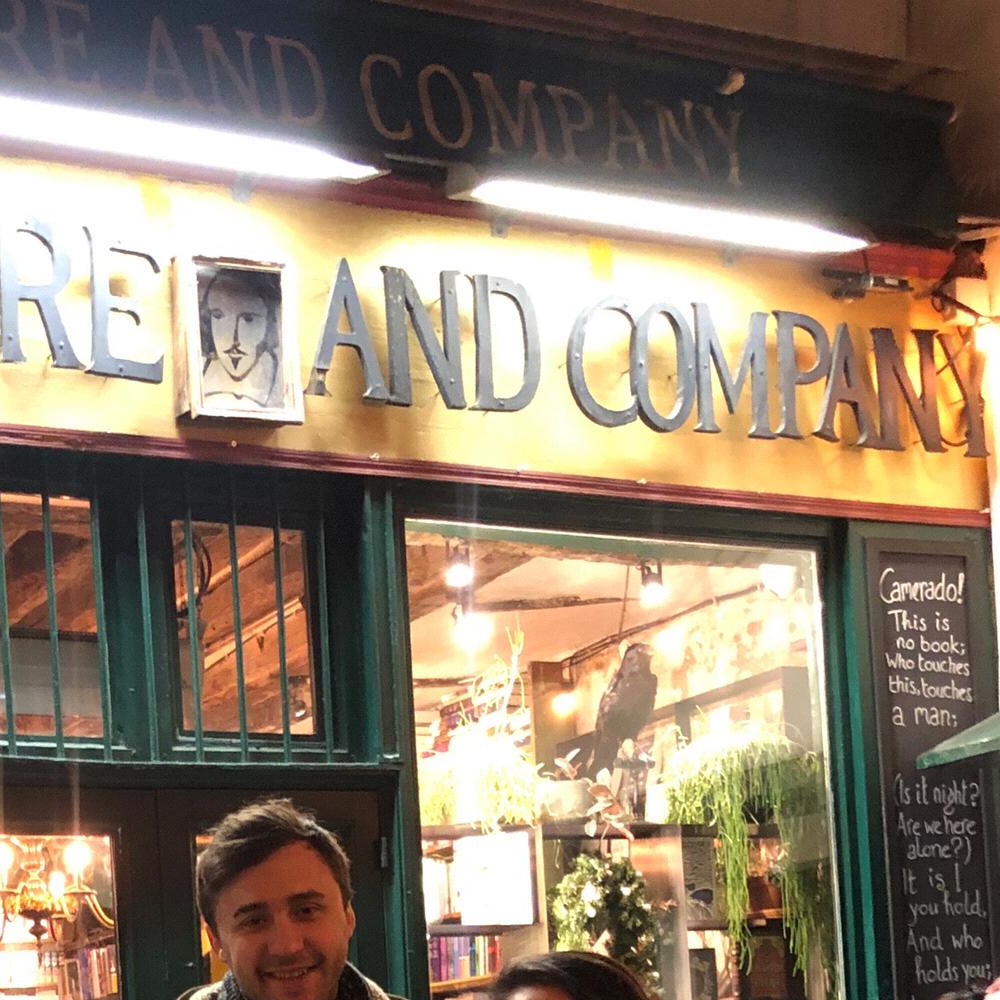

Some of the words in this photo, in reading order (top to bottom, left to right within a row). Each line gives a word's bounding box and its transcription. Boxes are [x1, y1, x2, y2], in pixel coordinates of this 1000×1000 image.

[142, 16, 327, 128] AND
[359, 53, 743, 186] COMPANY
[303, 256, 541, 412] AND
[566, 296, 990, 457] COMPANY
[879, 567, 965, 604] Camerado!
[887, 609, 927, 632] This
[935, 612, 950, 632] is
[896, 636, 915, 650] no
[920, 635, 966, 655] book;
[918, 653, 970, 677] touches
[921, 678, 973, 702] touches
[892, 706, 905, 727] a
[914, 706, 957, 728] man;
[915, 775, 929, 806] it
[933, 778, 980, 815] night?
[897, 812, 921, 837] Are
[925, 819, 942, 836] we
[944, 814, 977, 837] here
[907, 837, 972, 865] alone?)
[902, 867, 917, 896] It
[928, 868, 945, 890] is
[908, 903, 939, 927] you
[907, 926, 943, 951] And
[952, 924, 984, 950] who
[914, 955, 959, 985] holds
